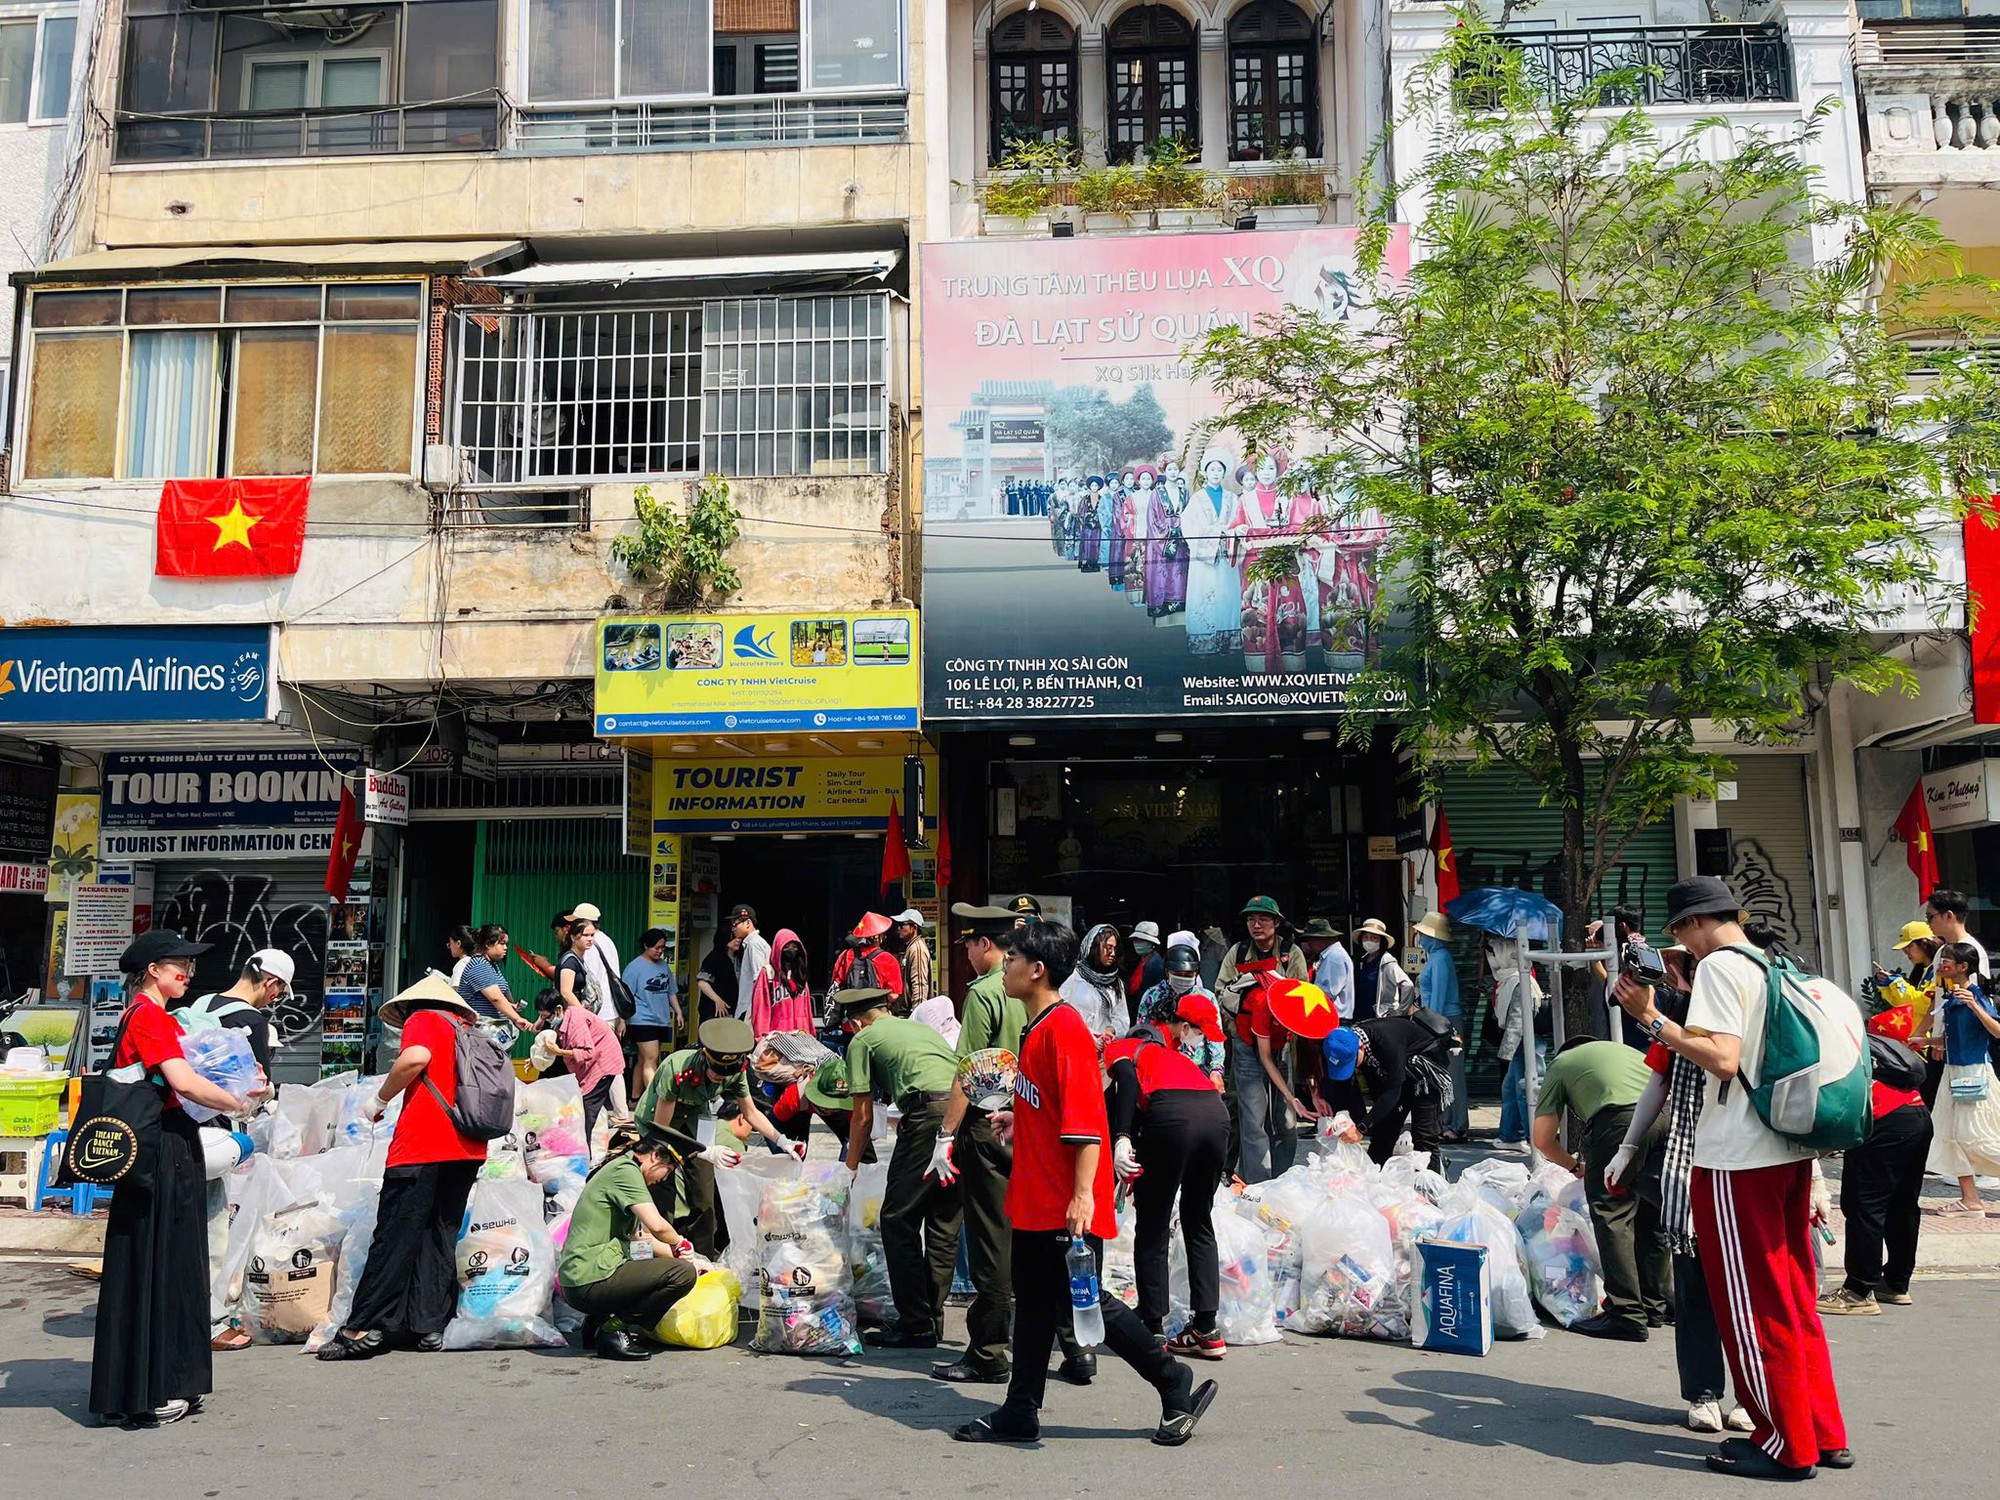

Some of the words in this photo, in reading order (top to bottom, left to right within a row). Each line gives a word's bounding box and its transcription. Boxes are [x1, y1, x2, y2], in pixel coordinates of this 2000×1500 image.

[944, 275, 1028, 298] TRUNG
[1034, 266, 1086, 296] TÂM
[1091, 266, 1157, 293] THÊU
[1165, 268, 1214, 296] LỤA
[1221, 255, 1285, 292] XQ
[974, 315, 1023, 347] ĐÀ
[1031, 317, 1091, 352] LẠT
[1097, 307, 1145, 343] SỬ
[1095, 364, 1123, 383] XQ
[1127, 361, 1161, 381] Silk
[944, 656, 986, 673] CÔNG
[987, 659, 1004, 672] TY
[1006, 658, 1047, 672] TNHH
[1048, 658, 1068, 673] XQ
[1071, 655, 1093, 671] SÀI
[1095, 654, 1129, 671] GÒN
[16, 659, 124, 694] Vietnam
[125, 656, 226, 693] Airlines
[229, 651, 260, 693] SKYTEAM
[696, 676, 724, 687] CÔNG
[725, 678, 738, 686] TY
[740, 677, 767, 686] TNHH
[769, 676, 817, 686] VietCruise
[945, 676, 971, 692] 106
[973, 673, 991, 691] LÊ
[993, 675, 1019, 694] LỢI,
[1022, 676, 1034, 691] P.
[1036, 672, 1063, 690] BẾN
[1066, 671, 1121, 692] THÀNH,
[1124, 675, 1143, 691] Q1
[1183, 674, 1239, 688] Website:
[945, 697, 974, 710] TEL:
[976, 697, 1003, 710] +84
[1005, 697, 1024, 710] 28
[1026, 695, 1095, 709] 38227725
[1183, 692, 1224, 706] Email:
[618, 717, 711, 728] contact@vietcruisetours.com
[738, 716, 801, 726] vietcruisetours.com
[827, 715, 853, 724] Hotline:
[853, 715, 866, 723] +84
[866, 715, 880, 723] 908
[881, 714, 894, 723] 785
[894, 714, 906, 723] 680
[119, 754, 146, 763] CTY
[149, 754, 187, 763] TNHH
[276, 752, 305, 761] LION
[309, 752, 353, 761] TRAVE
[424, 748, 449, 762] 108
[671, 765, 804, 790] TOURIST
[826, 769, 847, 780] Daily
[847, 770, 866, 779] Tour
[107, 772, 202, 804] TOUR
[368, 774, 406, 798] Buddha
[826, 779, 842, 787] Sim
[843, 779, 862, 787] Card
[826, 787, 852, 796] Airline
[859, 787, 879, 796] Train
[884, 787, 900, 795] Bus
[1926, 784, 1947, 804] Kim
[1947, 780, 1980, 801] Phượng
[667, 794, 806, 812] INFORMATION
[826, 796, 839, 805] Car
[840, 796, 867, 805] Rental
[20, 810, 46, 822] TOURS
[20, 823, 46, 835] TOURS
[1840, 829, 1860, 838] 104
[106, 836, 177, 853] TOURIST
[181, 834, 297, 852] INFORMATION
[299, 833, 335, 850] CEN
[20, 867, 30, 878] 4G
[36, 867, 47, 879] 5G
[19, 878, 46, 890] Esim
[78, 886, 109, 894] PACKAGE
[110, 886, 130, 894] TOURS
[95, 1130, 123, 1141] THEATRE
[93, 1138, 113, 1147] DANCE
[92, 1145, 119, 1156] VIETNAM
[1436, 1263, 1459, 1338] AQUAFINA
